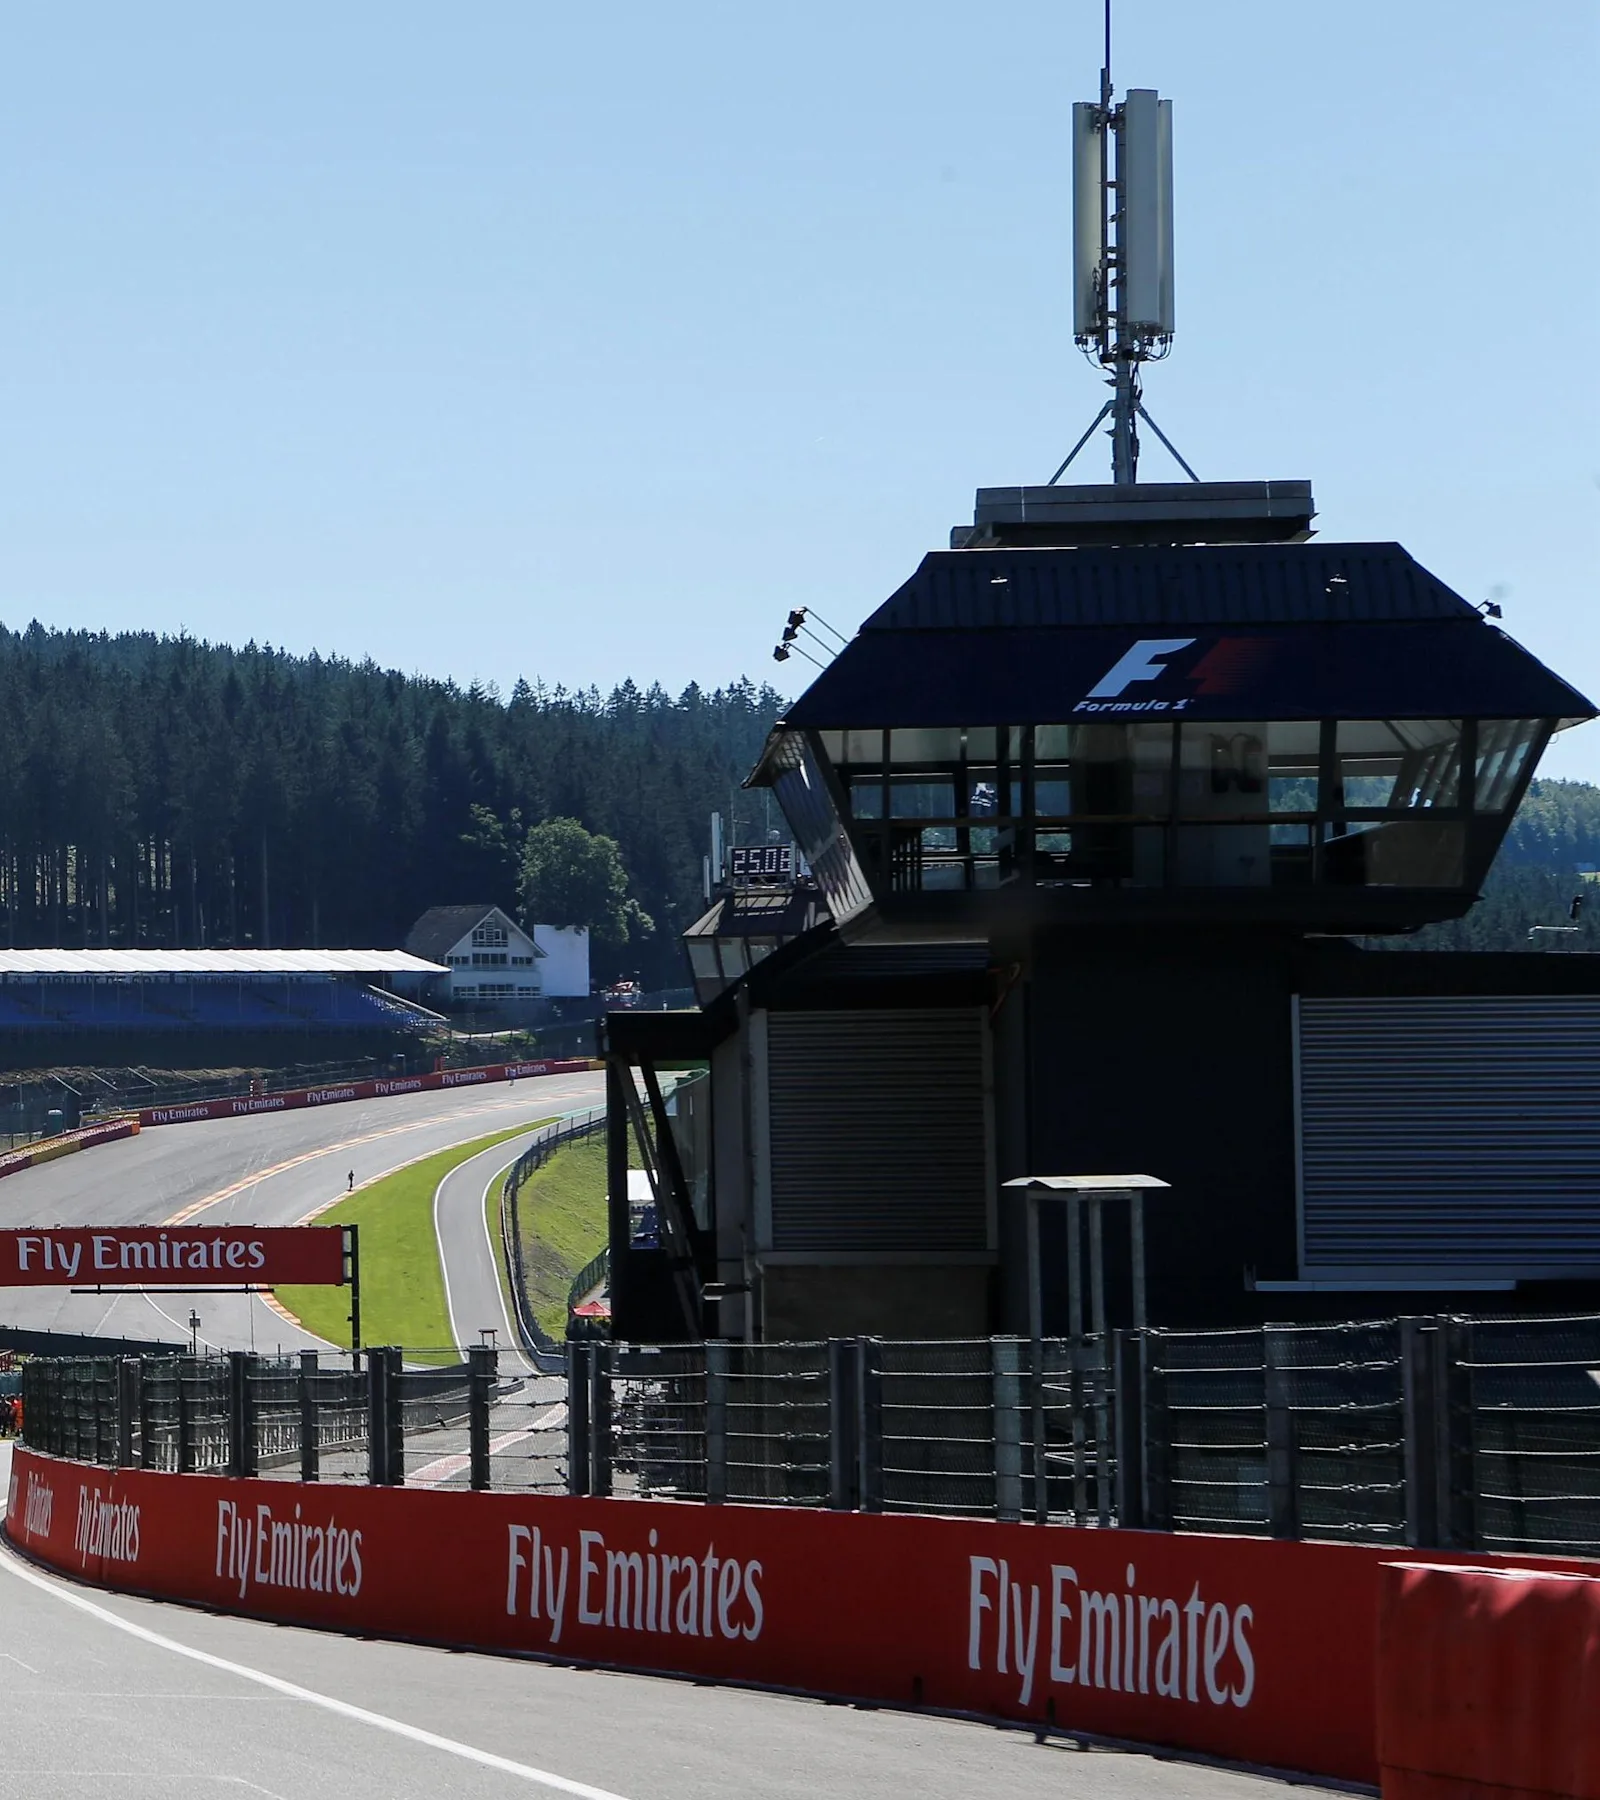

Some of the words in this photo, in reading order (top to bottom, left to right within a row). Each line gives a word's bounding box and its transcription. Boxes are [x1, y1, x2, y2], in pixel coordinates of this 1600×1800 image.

[1072, 699, 1168, 712] Formula
[1172, 698, 1190, 711] 1
[375, 1082, 390, 1094] Fly
[390, 1078, 422, 1092] Emirates
[442, 1073, 454, 1085] Fly
[454, 1070, 487, 1083] Emirates
[307, 1092, 321, 1104] Fly
[321, 1086, 355, 1101] Emirates
[232, 1101, 248, 1114] Fly
[249, 1096, 285, 1110] Emirates
[152, 1110, 168, 1123] Fly
[170, 1106, 209, 1120] Emirates
[18, 1236, 83, 1278] Fly
[91, 1233, 266, 1270] Emirates
[75, 1484, 93, 1568] Fly
[89, 1485, 140, 1563] Emirates
[215, 1500, 252, 1599] Fly
[254, 1503, 363, 1597] Emirates
[506, 1523, 569, 1643] Fly
[578, 1528, 763, 1642] Emirates
[968, 1555, 1040, 1707] Fly
[1050, 1562, 1256, 1709] Emirates
